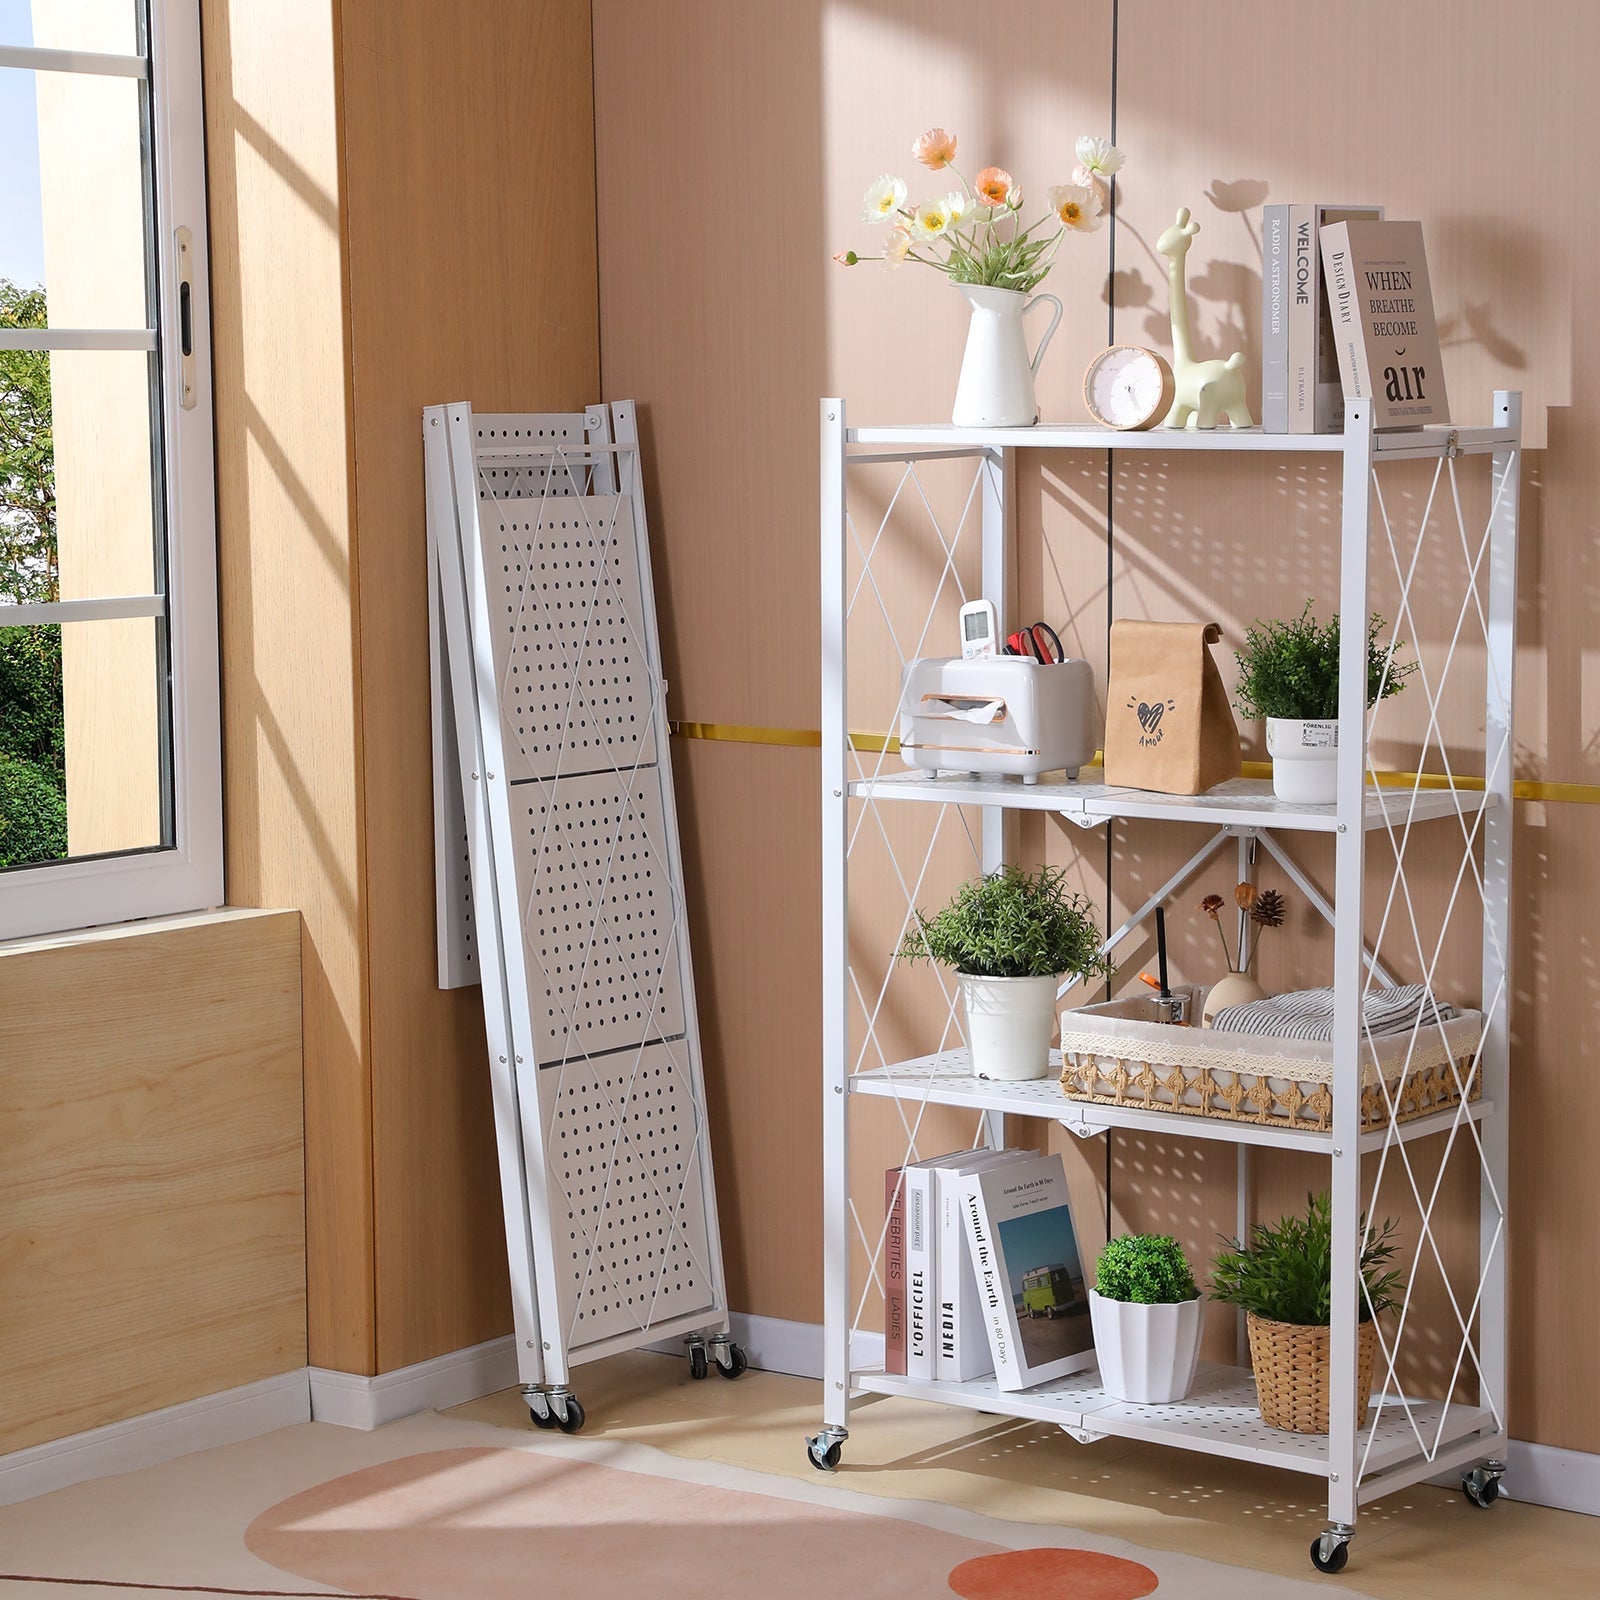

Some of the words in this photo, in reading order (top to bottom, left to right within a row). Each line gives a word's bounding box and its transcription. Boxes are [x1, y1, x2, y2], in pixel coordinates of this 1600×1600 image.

[1271, 219, 1280, 254] RADIO
[1297, 221, 1309, 305] WELCOME
[1332, 251, 1347, 290] DESIGN
[1271, 258, 1280, 335] ASTRONOMER
[1364, 271, 1413, 291] WHEN
[1338, 291, 1352, 323] DIARY
[1369, 298, 1416, 314] BREATHE
[1373, 321, 1418, 337] BECOME
[1383, 366, 1426, 402] air
[1139, 728, 1164, 747] AMOUR
[890, 1189, 901, 1280] CELEBRITIES
[967, 1193, 986, 1243] Around
[979, 1246, 989, 1267] the
[983, 1270, 998, 1308] Earth
[891, 1296, 900, 1340] LADIES
[913, 1270, 924, 1357] L'OFFICIEL
[942, 1302, 954, 1359] INEDIA
[993, 1315, 1000, 1326] in
[995, 1327, 1004, 1340] 80
[998, 1341, 1008, 1365] Days
